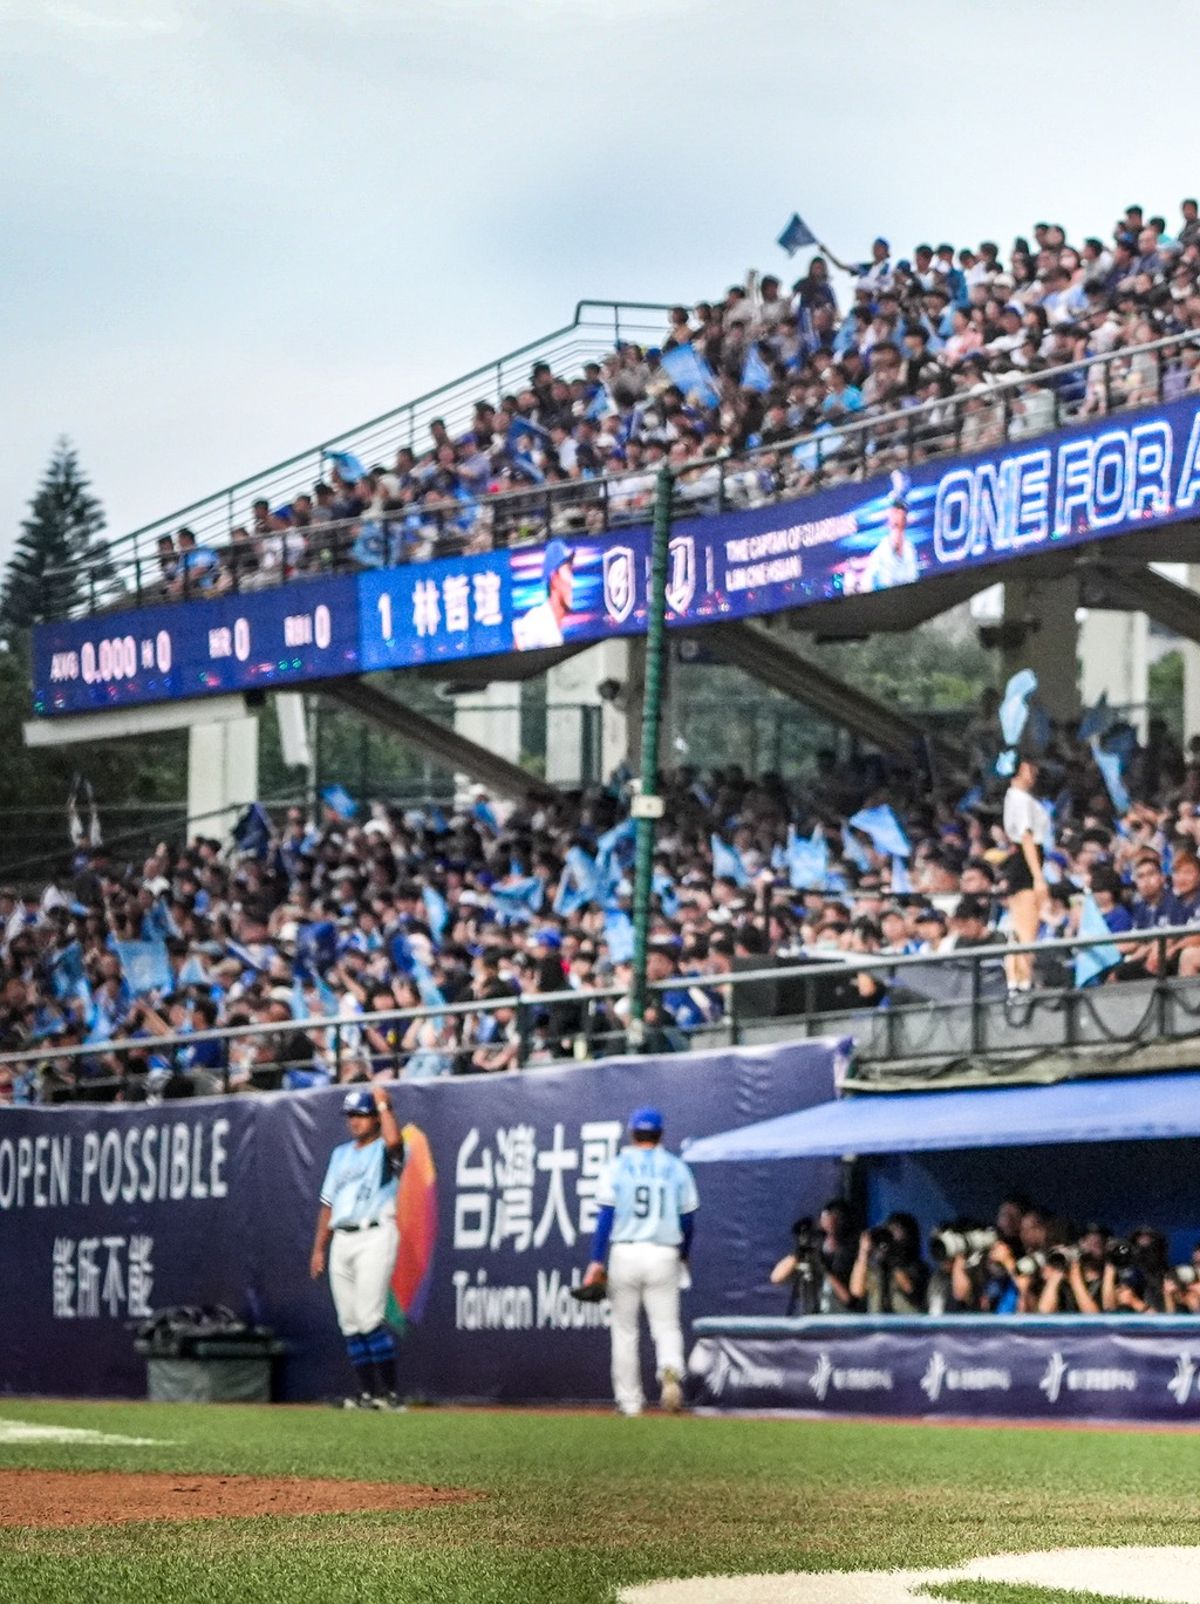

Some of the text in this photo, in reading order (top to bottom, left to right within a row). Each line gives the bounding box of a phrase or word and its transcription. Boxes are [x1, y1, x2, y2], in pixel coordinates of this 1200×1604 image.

[934, 449, 1052, 563] ONE
[1055, 421, 1174, 537] FOR
[81, 635, 137, 685] 0.000
[156, 630, 172, 673] 0
[234, 616, 250, 662] 0
[314, 604, 331, 649] 0
[377, 592, 392, 640] 1
[0, 1118, 230, 1210] OPEN POSSIBLE
[453, 1121, 623, 1252] 台灣大哥
[634, 1185, 666, 1219] 91
[452, 1268, 534, 1331] Taiwan
